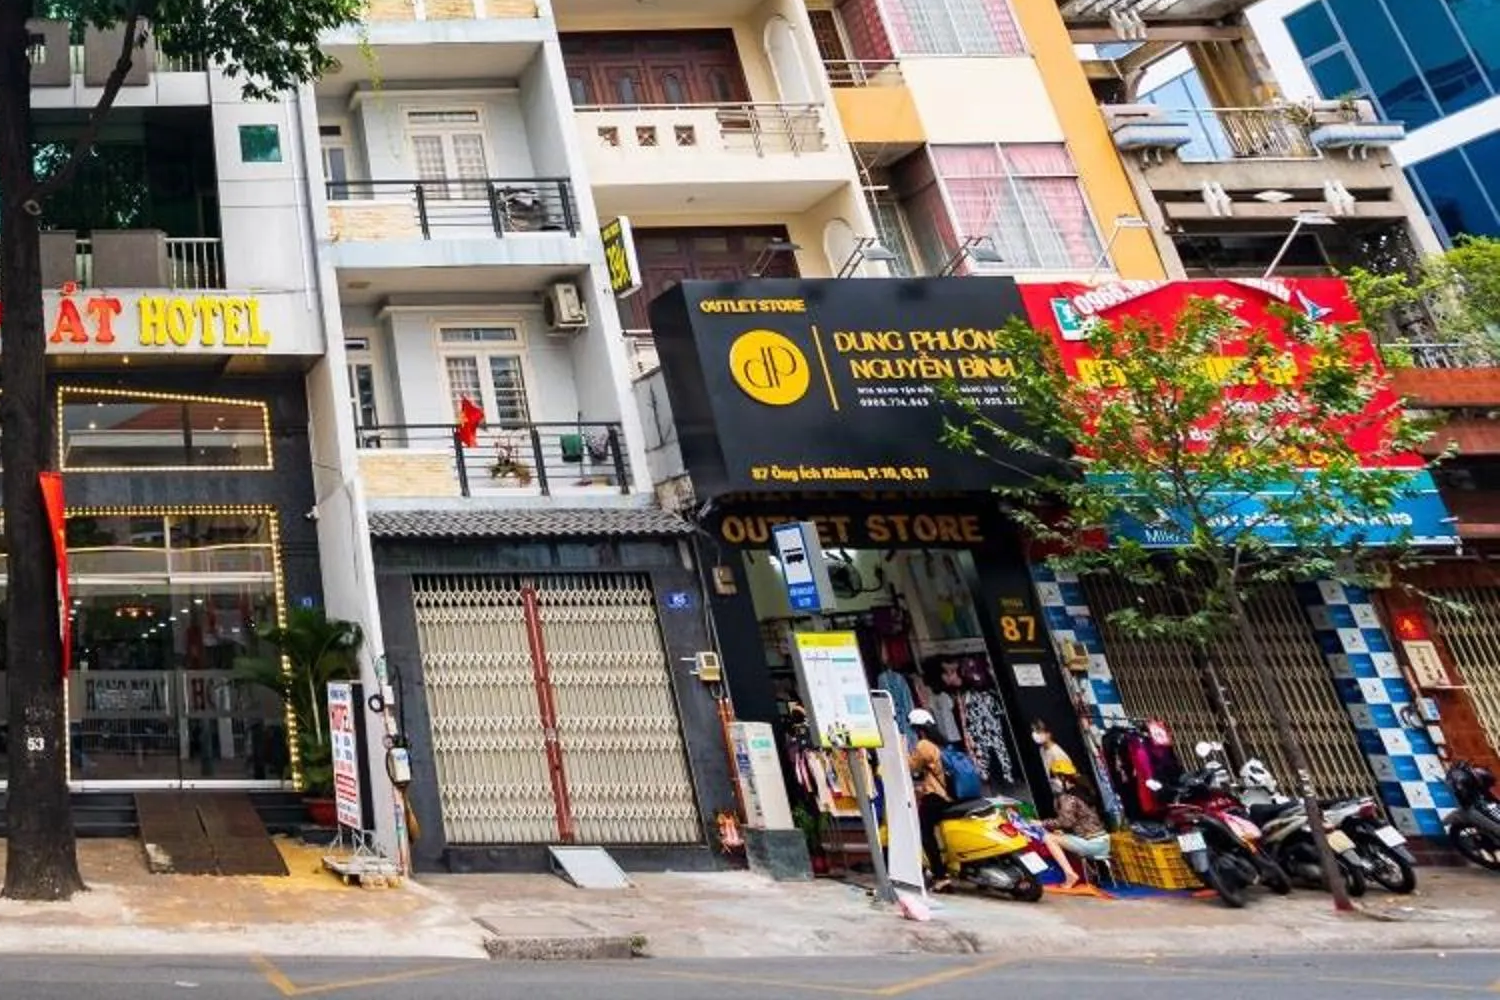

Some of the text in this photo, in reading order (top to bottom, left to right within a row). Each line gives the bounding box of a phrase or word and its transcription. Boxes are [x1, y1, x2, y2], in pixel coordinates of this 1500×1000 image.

[700, 298, 806, 313] OUTLET STORE
[137, 296, 271, 347] HOTEL
[833, 331, 904, 352] DUNG
[771, 465, 799, 482] Ông
[721, 515, 983, 543] OUET STORE
[1000, 615, 1035, 642] 87
[27, 737, 45, 751] 53
